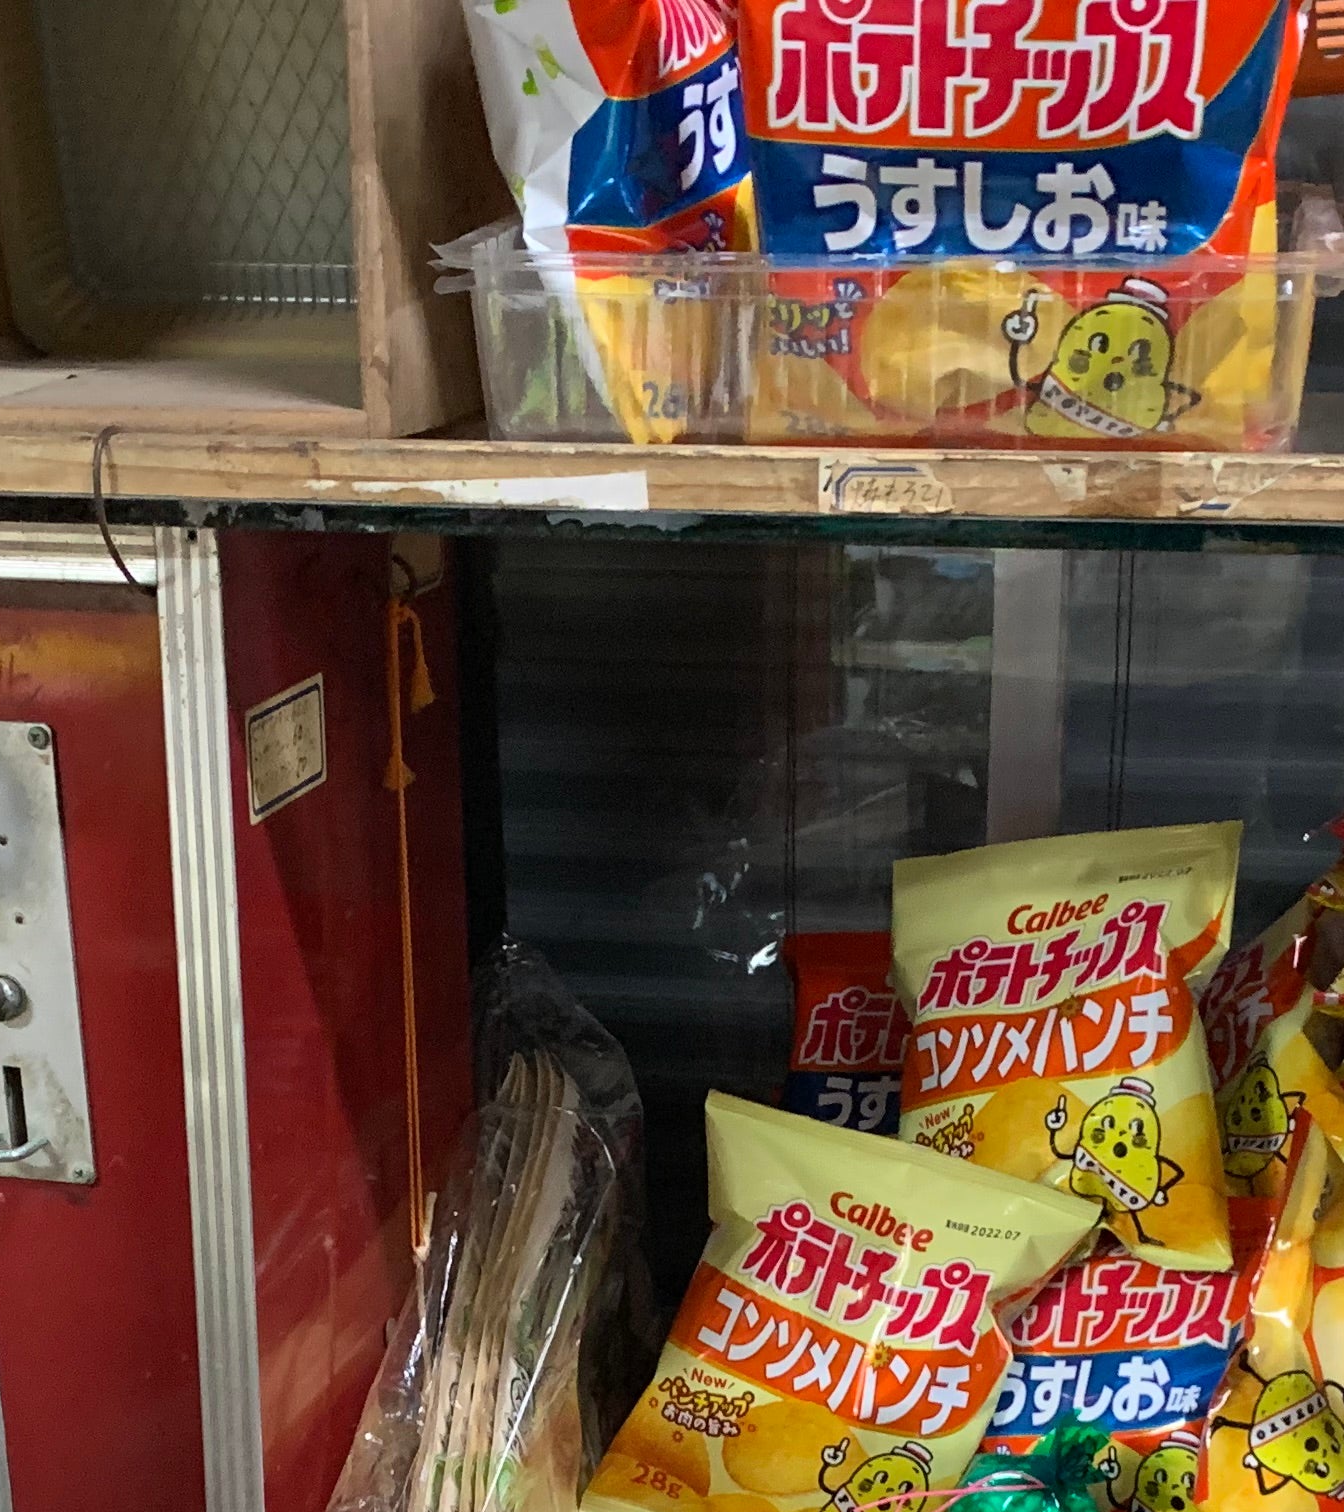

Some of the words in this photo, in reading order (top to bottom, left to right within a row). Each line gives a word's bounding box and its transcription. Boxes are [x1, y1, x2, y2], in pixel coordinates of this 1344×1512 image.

[769, 0, 1208, 140] ポテトチップス
[813, 153, 1170, 258] うすしお味
[916, 900, 1169, 1015] ポテトチップス
[1006, 892, 1110, 936] Calbee
[916, 988, 1174, 1093] コンソメパンチ
[829, 1191, 934, 1253] Calbee
[737, 1200, 995, 1357] ポテトチップス
[690, 1367, 729, 1390] New
[697, 1287, 971, 1437] コンソメパンチ
[992, 1355, 1202, 1427] うすしお味
[661, 1402, 741, 1439] お肉の旨み
[630, 1461, 683, 1501] 28g
